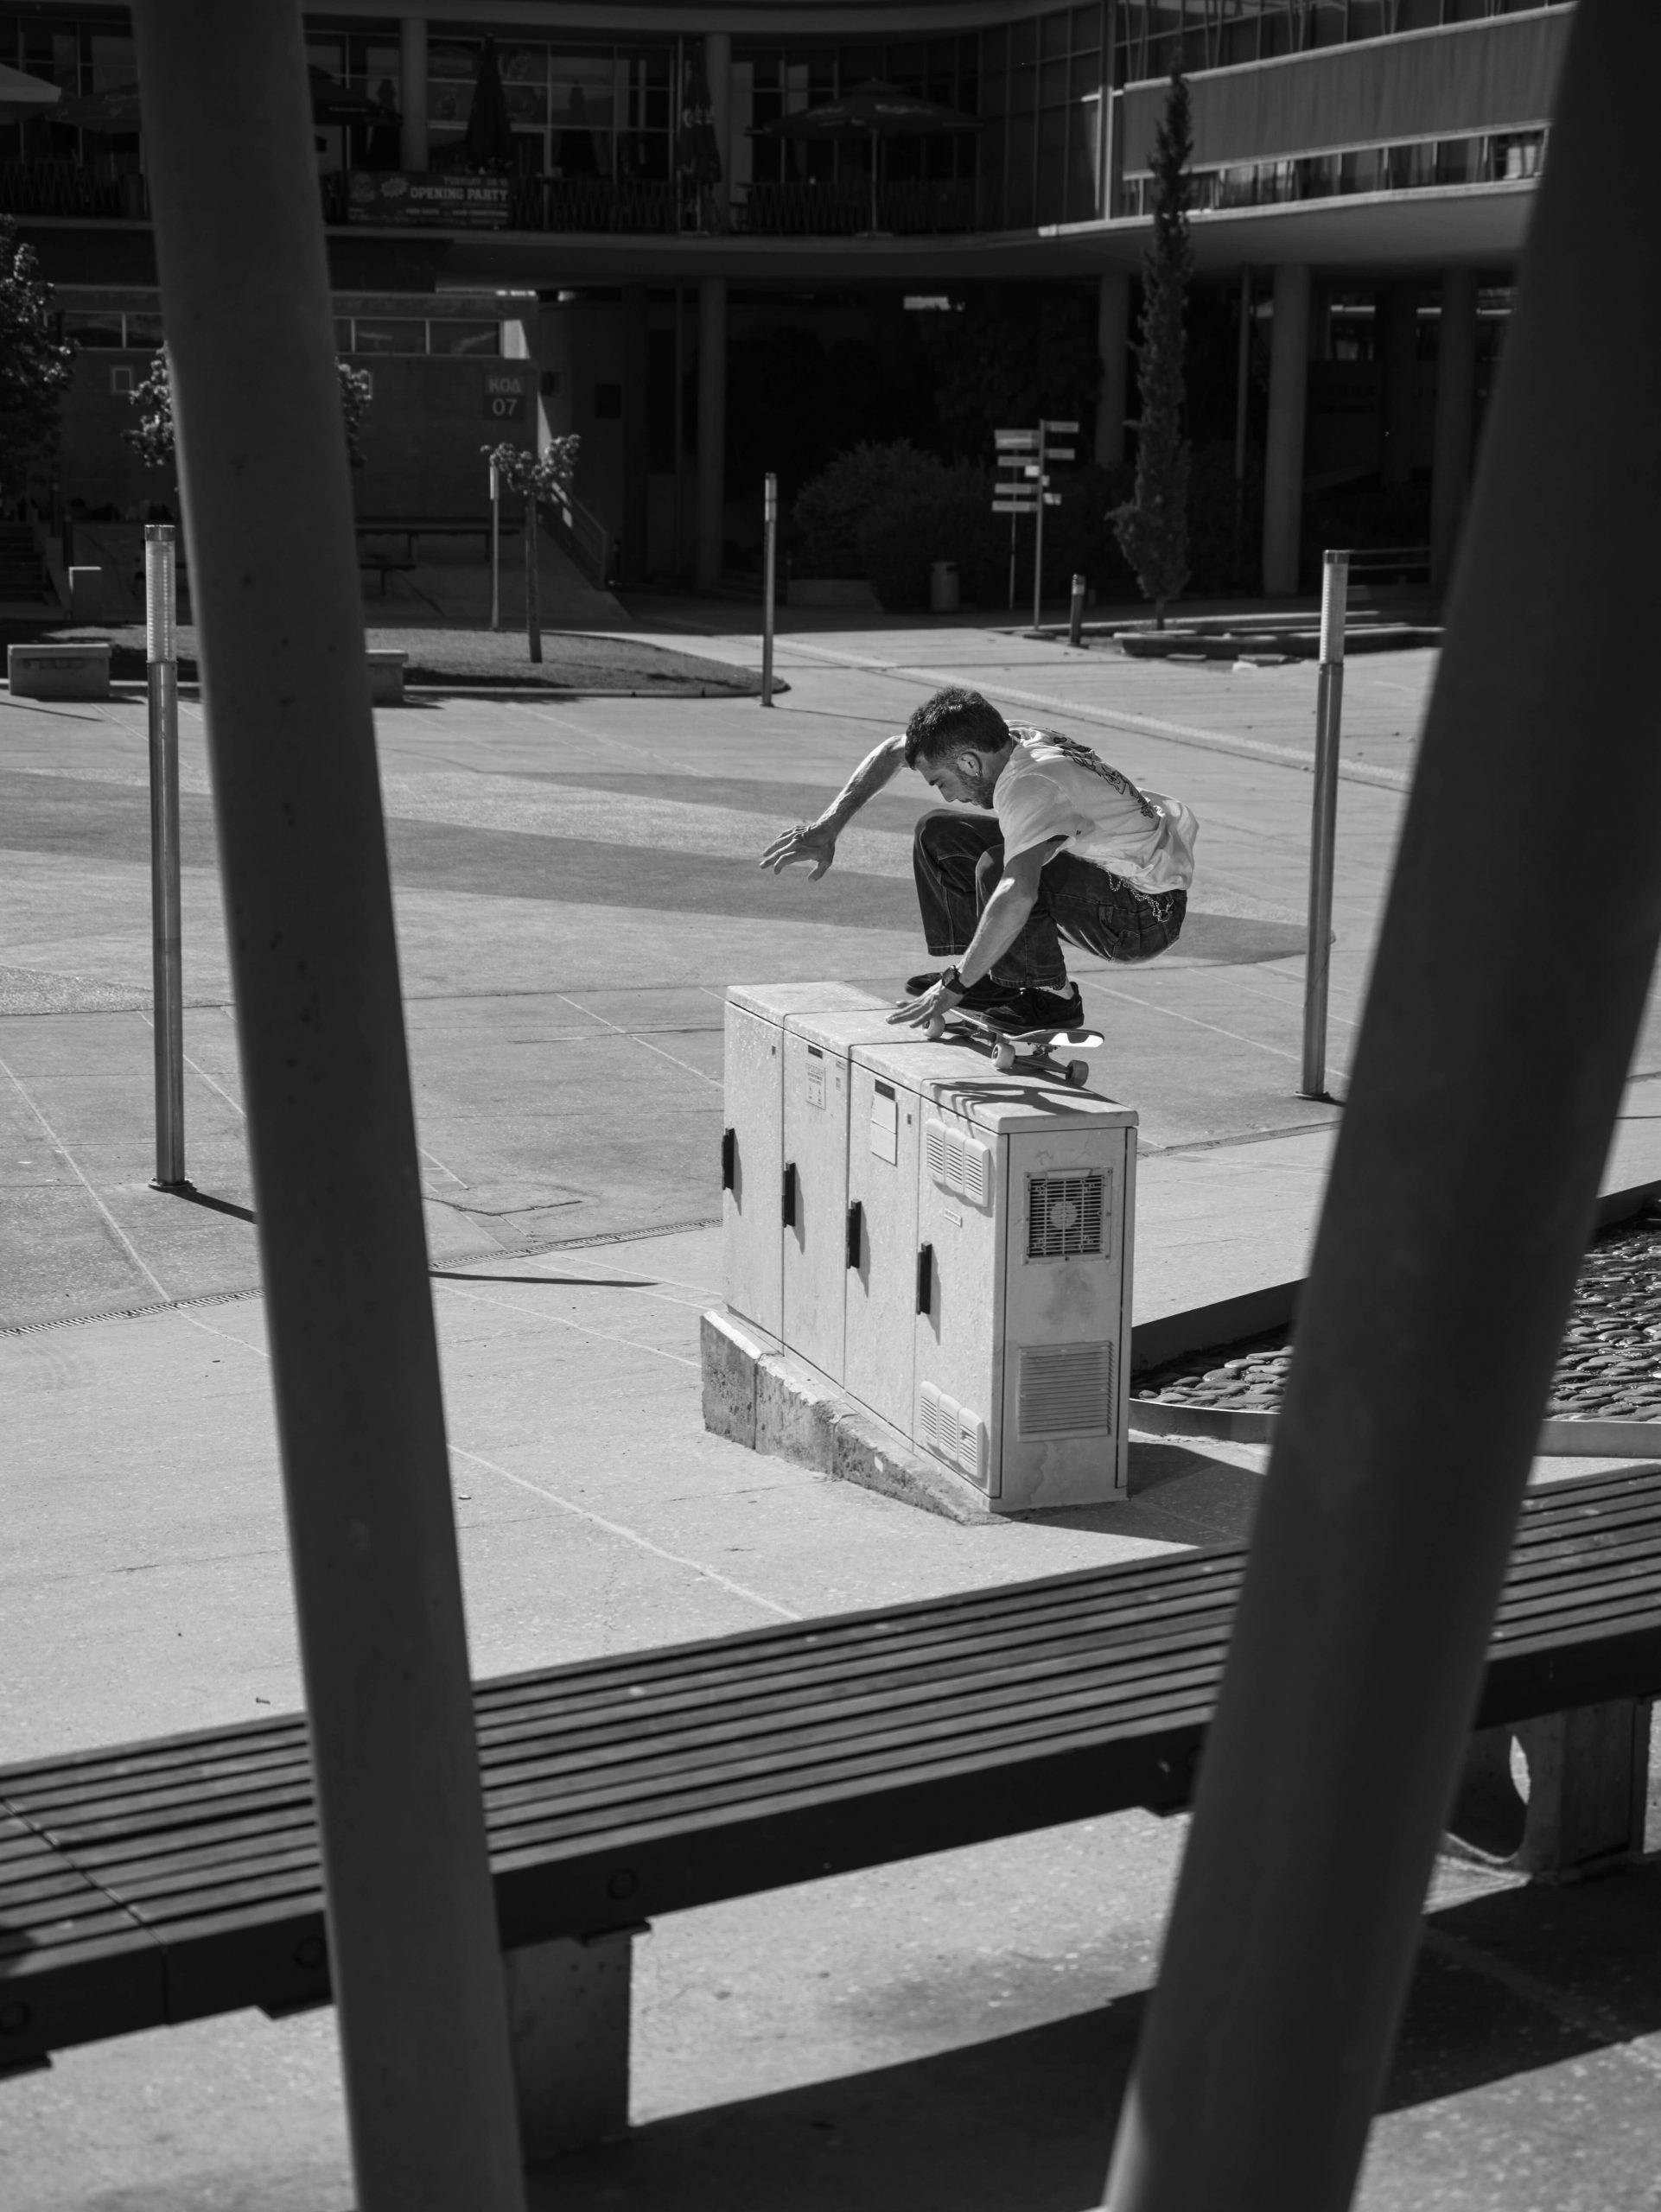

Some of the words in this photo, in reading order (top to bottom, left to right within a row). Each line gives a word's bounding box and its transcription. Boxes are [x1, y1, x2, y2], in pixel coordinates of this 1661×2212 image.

[410, 187, 465, 200] OPENING
[467, 188, 509, 202] PARTY
[492, 397, 519, 416] 07
